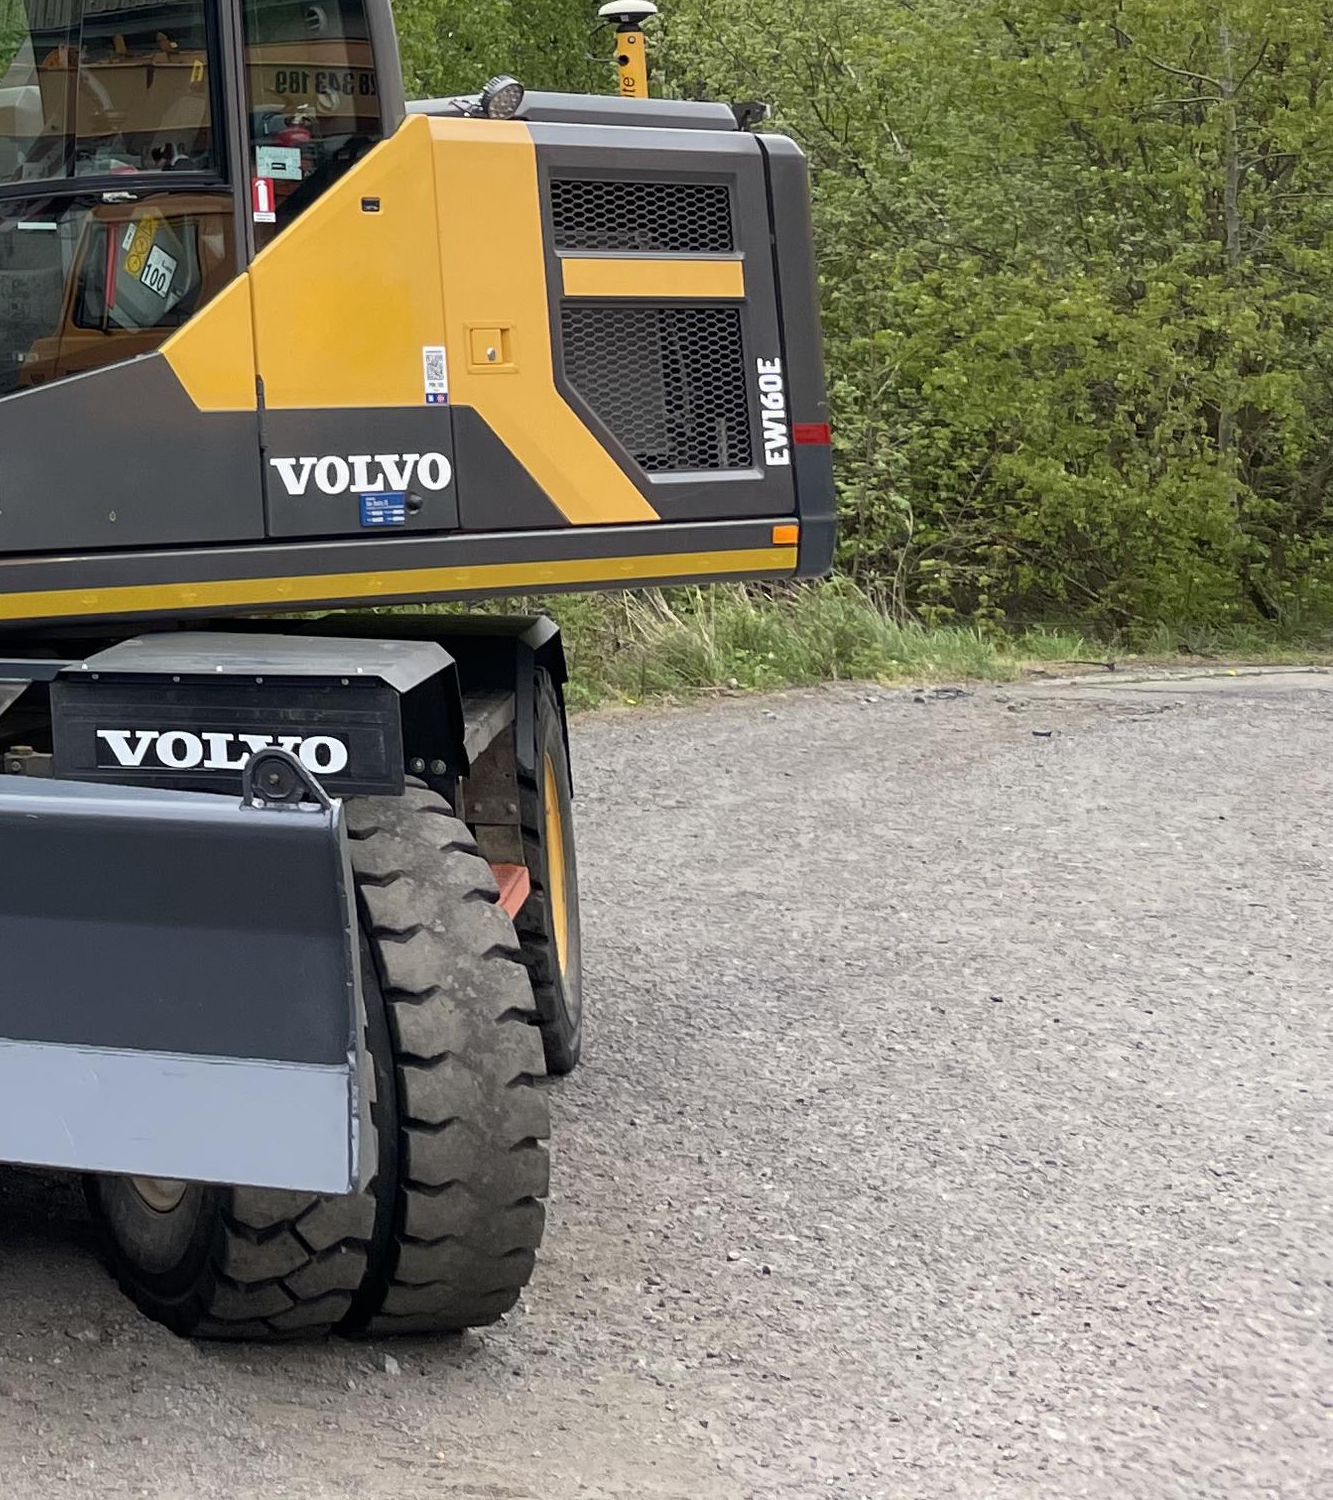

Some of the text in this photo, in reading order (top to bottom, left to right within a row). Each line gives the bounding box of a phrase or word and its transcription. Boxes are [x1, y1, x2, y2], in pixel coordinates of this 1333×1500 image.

[144, 263, 167, 292] 100
[756, 357, 790, 465] EW160E
[269, 452, 452, 495] VOLVO
